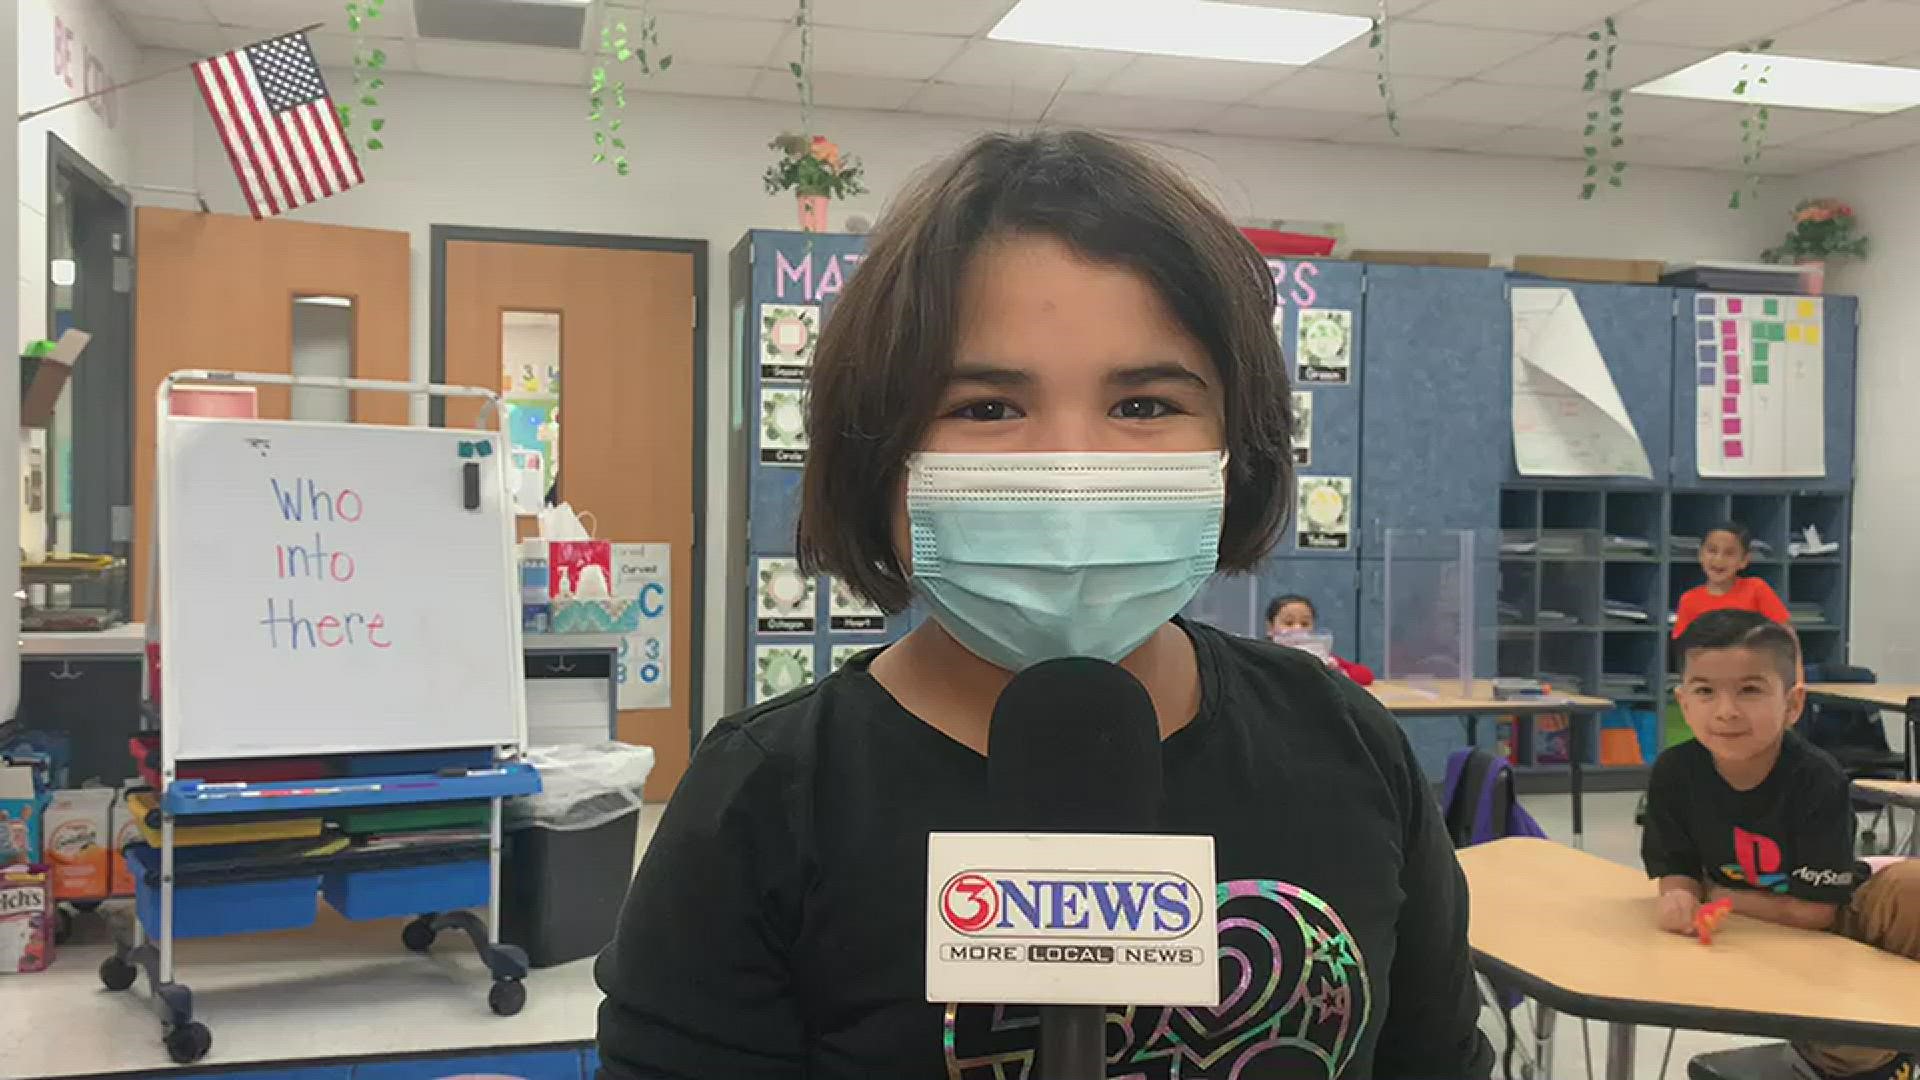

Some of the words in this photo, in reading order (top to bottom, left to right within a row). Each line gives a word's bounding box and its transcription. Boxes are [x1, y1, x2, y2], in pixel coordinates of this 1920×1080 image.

[270, 477, 364, 523] Who
[639, 582, 664, 618] C
[260, 597, 393, 650] there
[0, 887, 42, 912] lch's
[996, 879, 1192, 933] NEWS
[950, 946, 1018, 961] MORE
[1032, 947, 1113, 963] LOCAL
[1125, 949, 1194, 964] NEWS
